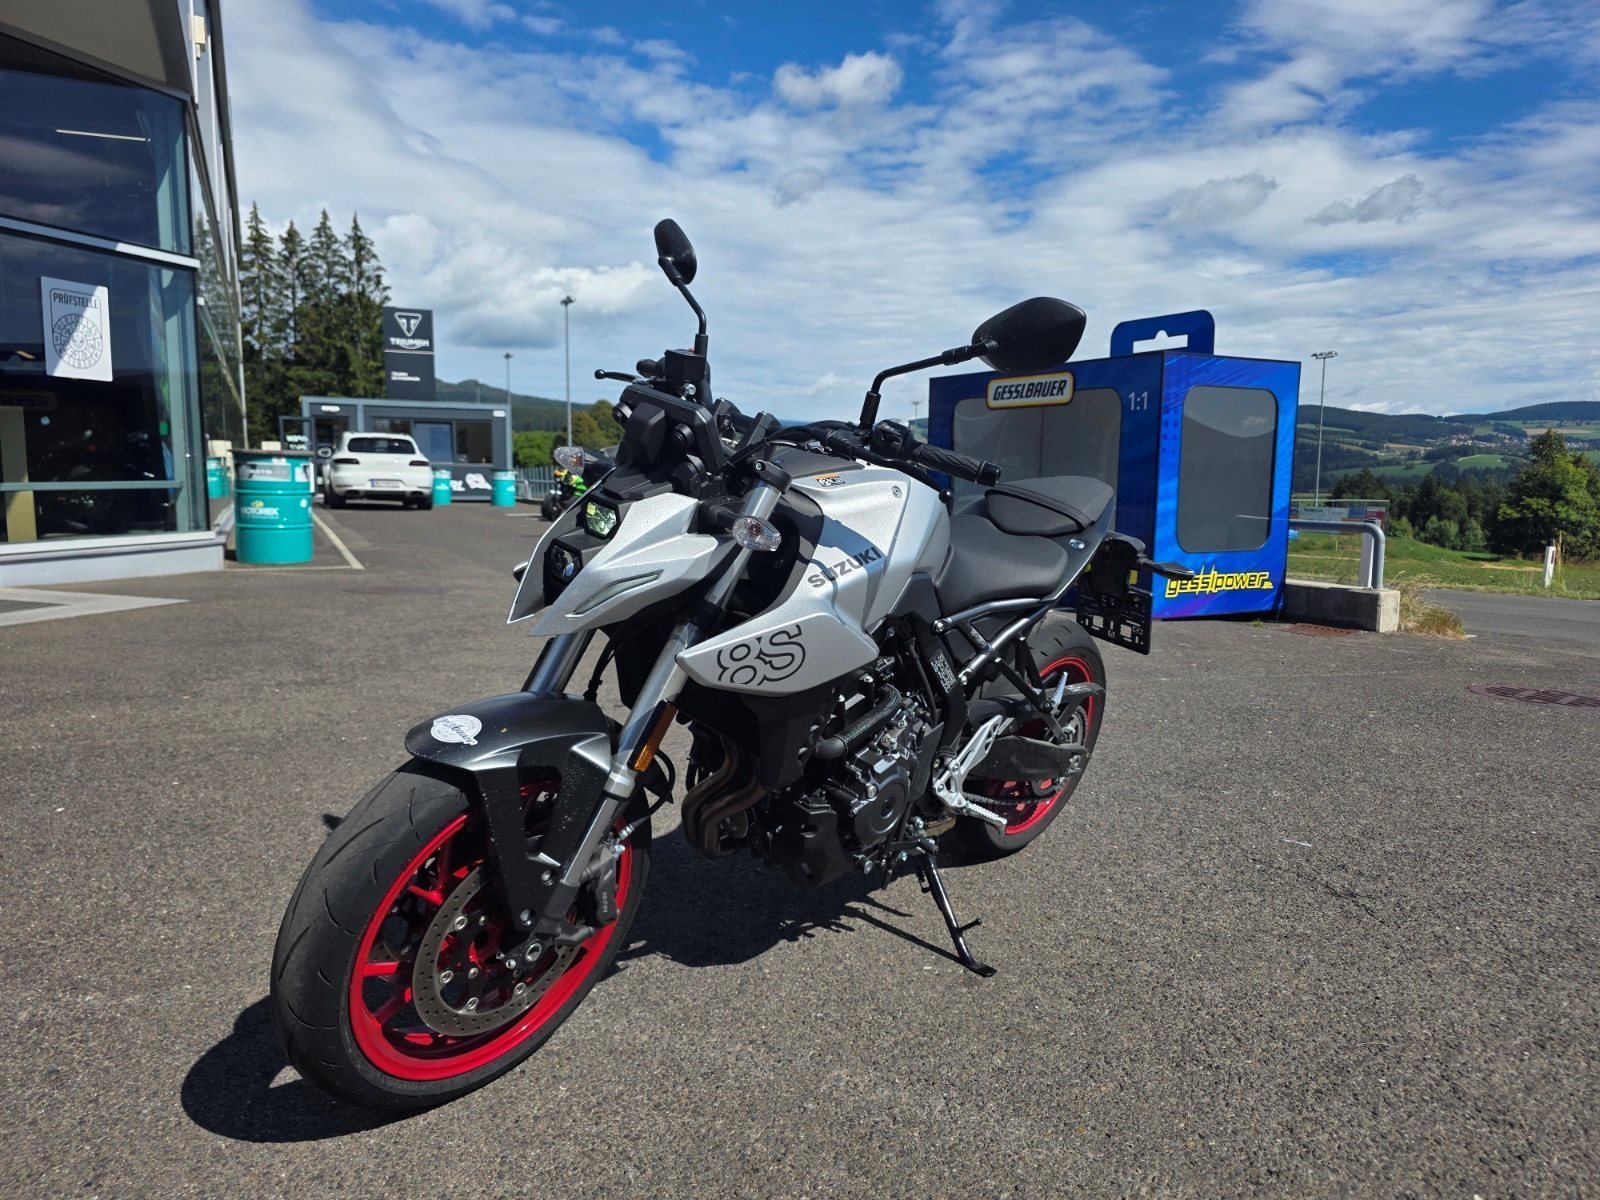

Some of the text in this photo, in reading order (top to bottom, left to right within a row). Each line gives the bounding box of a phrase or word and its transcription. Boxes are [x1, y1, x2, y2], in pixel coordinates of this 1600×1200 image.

[53, 291, 99, 309] PRÜFSTELLE
[993, 379, 1068, 401] GESSLBAUER
[1128, 391, 1148, 411] 1:1
[807, 546, 882, 588] SUZUKI
